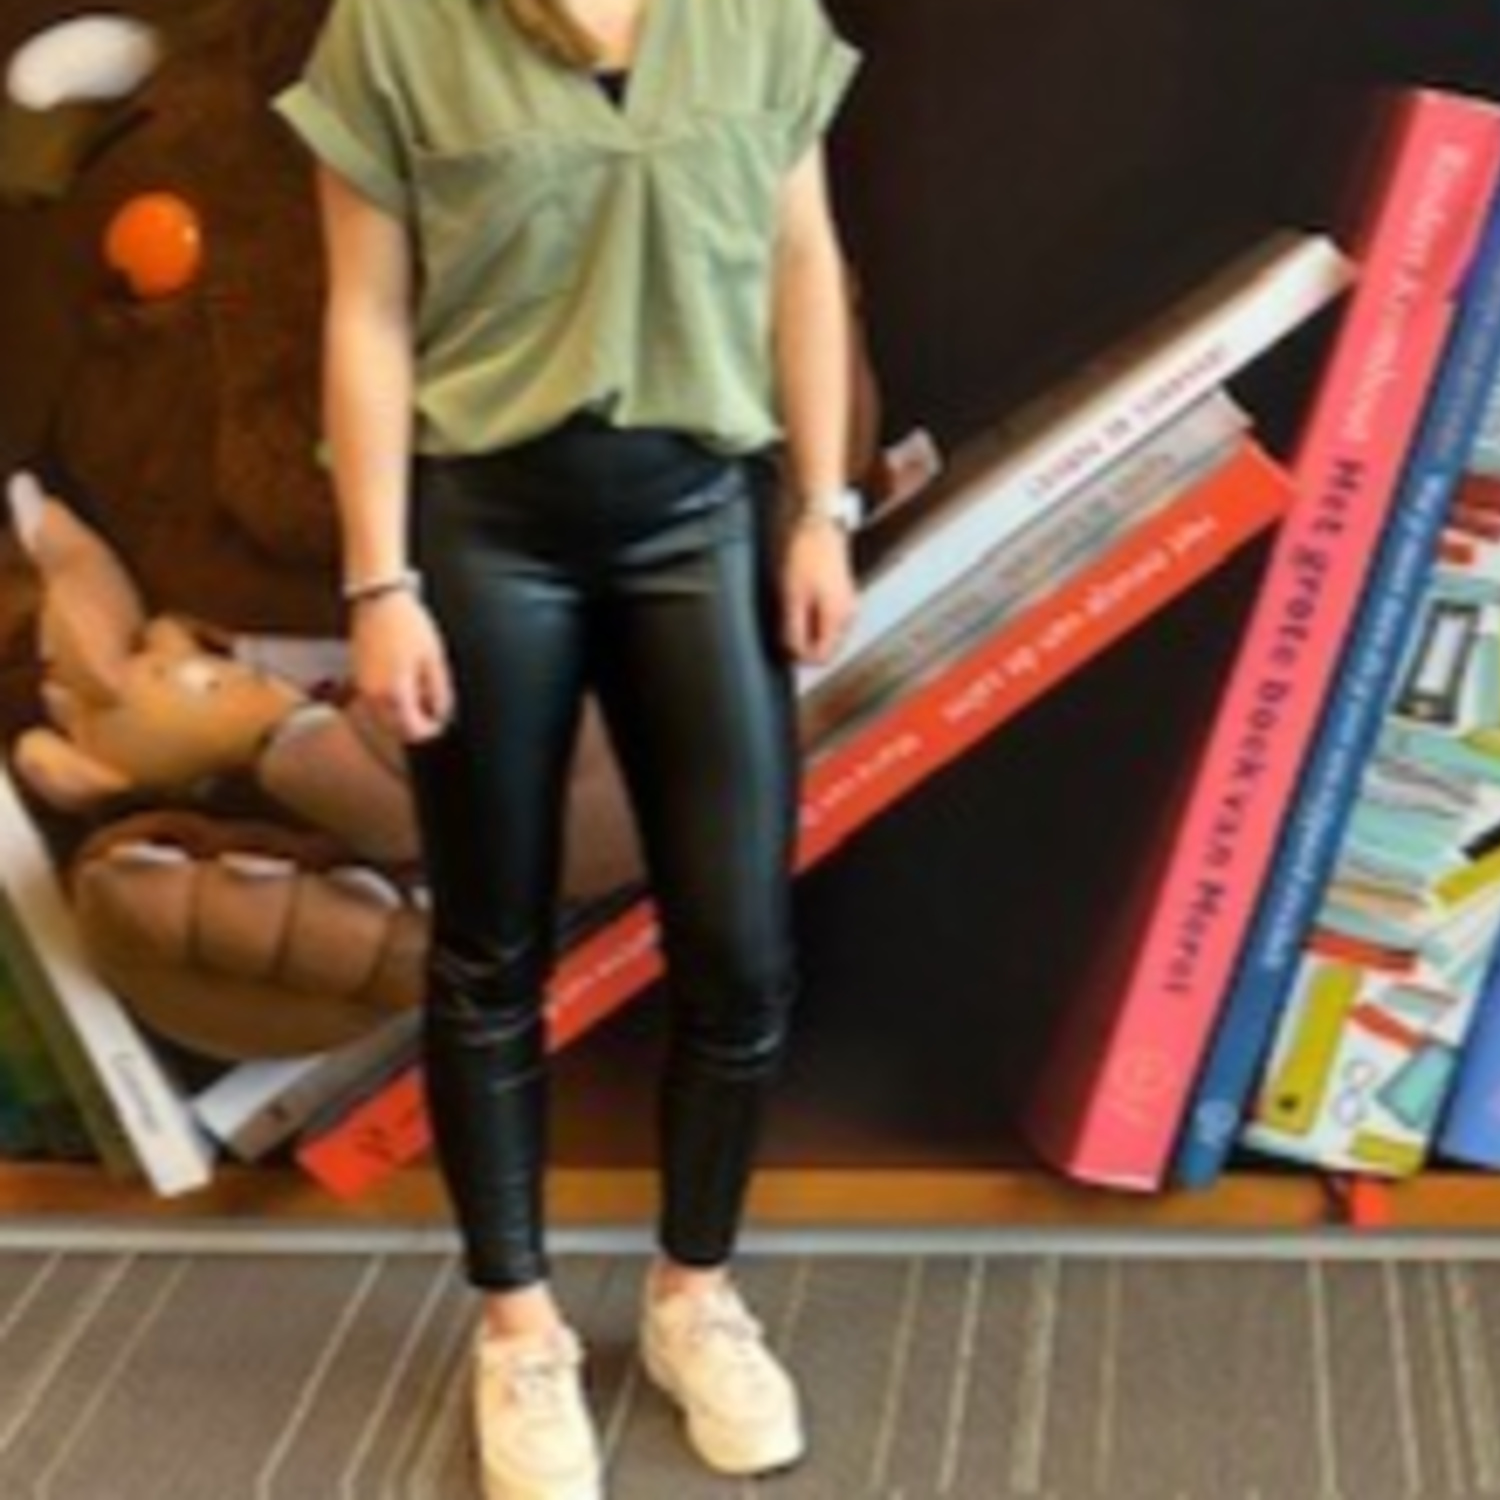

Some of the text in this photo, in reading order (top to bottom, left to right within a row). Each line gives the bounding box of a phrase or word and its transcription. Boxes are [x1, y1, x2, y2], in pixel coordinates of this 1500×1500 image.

[1160, 453, 1366, 996] Het grote boek van Merel
